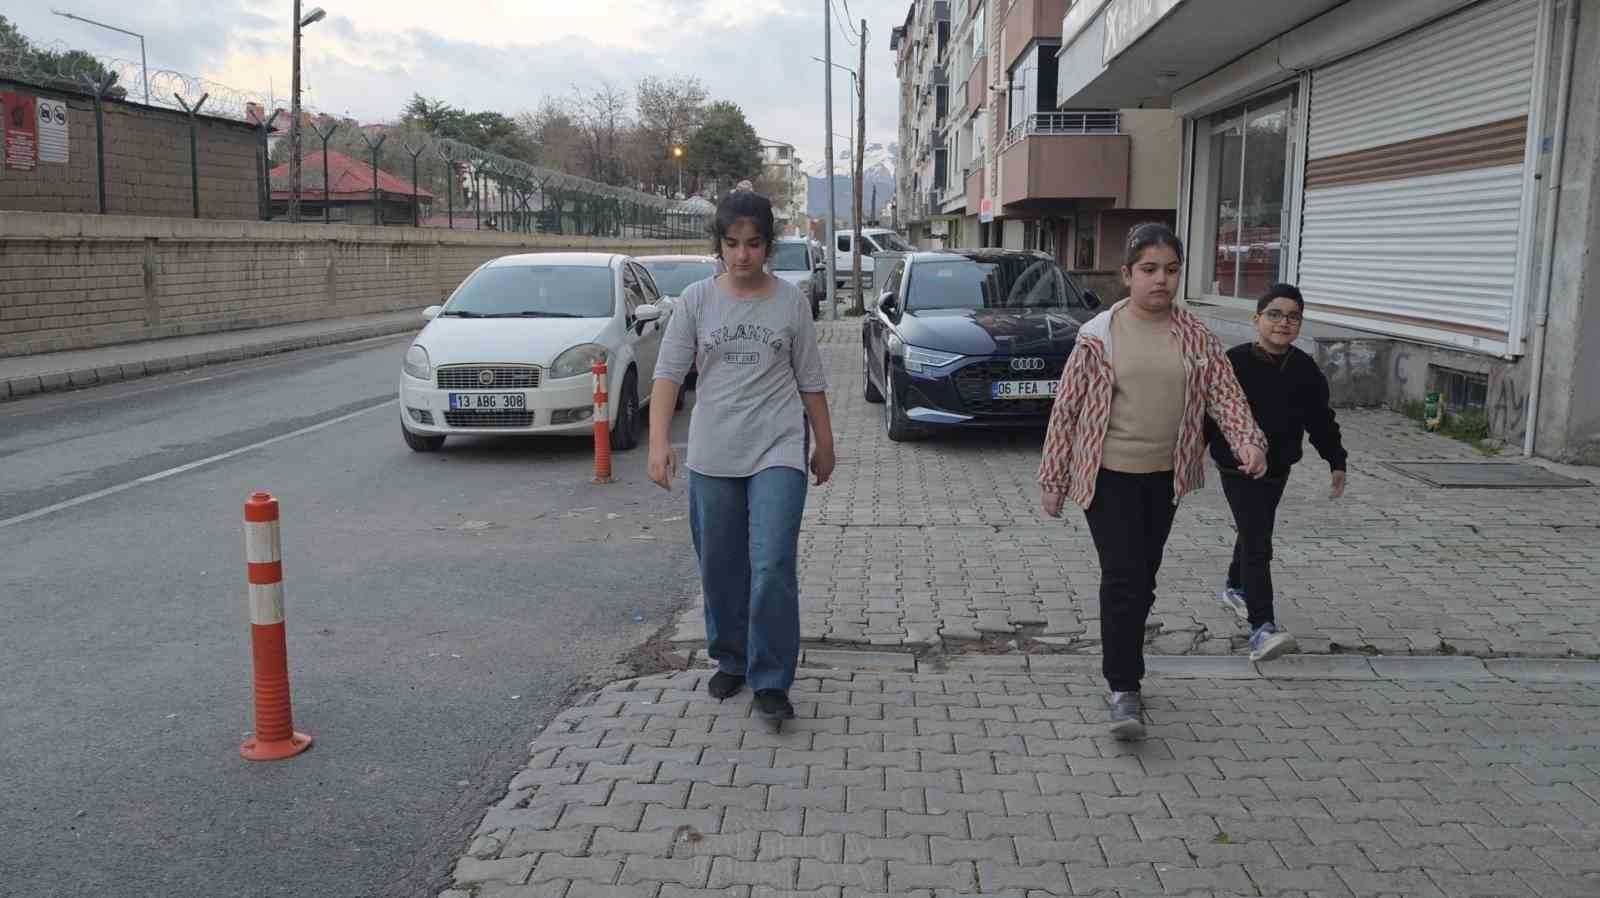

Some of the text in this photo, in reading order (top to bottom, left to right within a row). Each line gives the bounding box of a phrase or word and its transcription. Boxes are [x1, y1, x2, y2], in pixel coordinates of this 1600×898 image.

[999, 382, 1058, 394] 06 FEA 12
[459, 395, 470, 407] 13
[503, 395, 523, 407] 308
